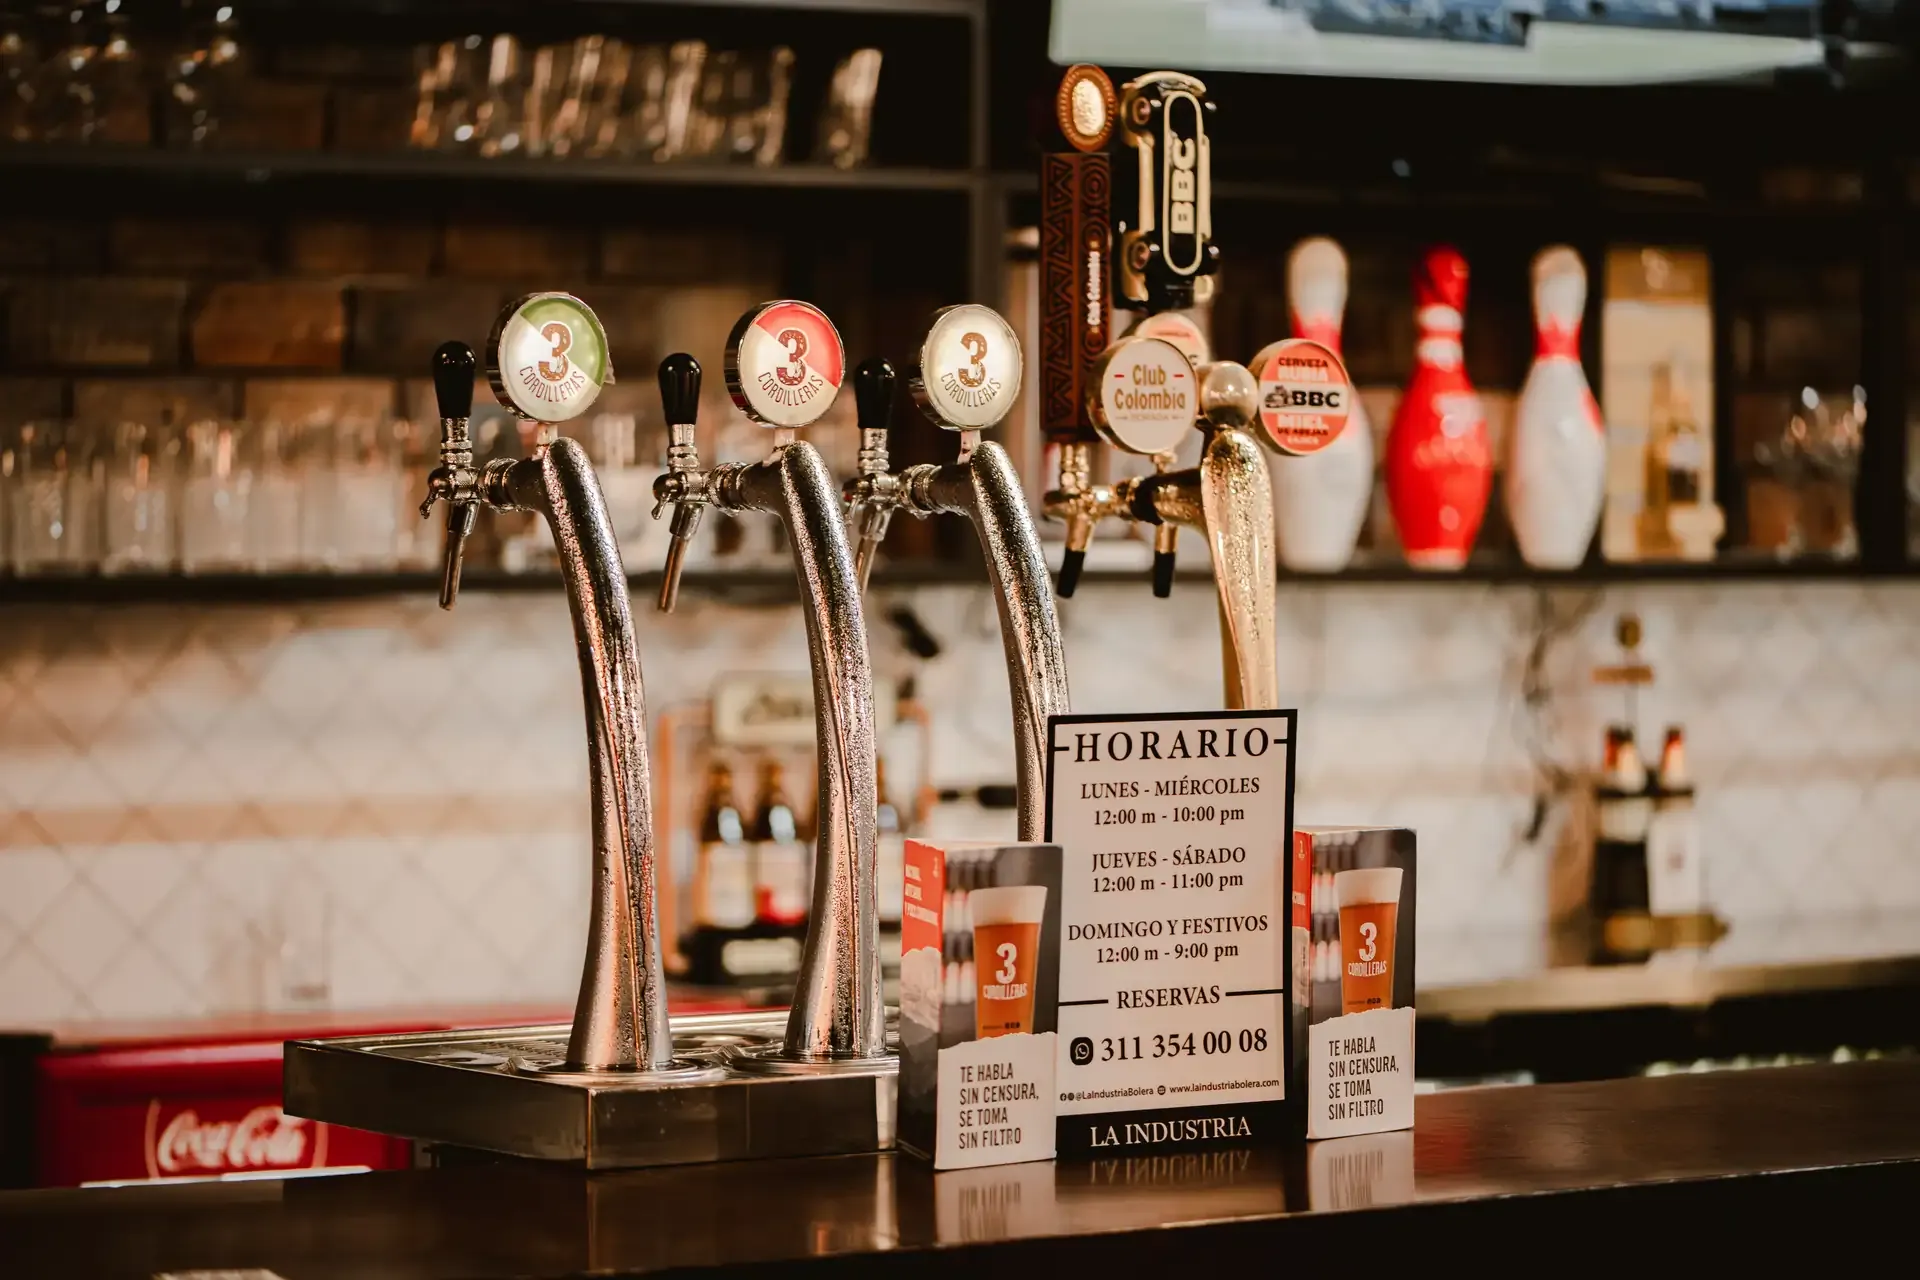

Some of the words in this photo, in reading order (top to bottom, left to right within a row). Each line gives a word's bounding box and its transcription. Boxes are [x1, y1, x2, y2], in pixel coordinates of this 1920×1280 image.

[1171, 137, 1196, 234] BBC
[538, 322, 573, 382] 3
[776, 329, 808, 386] 3
[958, 332, 988, 388] 3
[1278, 357, 1329, 368] CERVEZA
[519, 365, 586, 402] CORDILLERAS
[1132, 364, 1167, 386] Club
[758, 371, 824, 406] CORDILLERAS
[941, 372, 1002, 408] CORDILLERAS
[1114, 387, 1186, 410] Colombia
[1292, 390, 1340, 408] BBC
[1074, 727, 1269, 762] HORARIO
[1081, 781, 1139, 799] LUNES
[1154, 775, 1260, 797] MIÉRCOLES
[1094, 808, 1136, 825] 12:00
[1141, 812, 1156, 824] m
[1172, 806, 1215, 823] 10:00
[1220, 808, 1245, 825] pm
[1092, 851, 1157, 872] JUEVES
[1172, 845, 1246, 865] SÁBADO
[1093, 876, 1135, 893] 12:00
[1140, 878, 1155, 890] m
[1172, 872, 1214, 889] 11:00
[1219, 873, 1243, 891] pm
[1068, 919, 1163, 941] DOMINGO
[1167, 919, 1179, 936] Y
[1182, 915, 1268, 935] FESTIVOS
[1097, 946, 1139, 963] 12:00
[1144, 948, 1159, 960] m
[1174, 943, 1208, 959] 9:00
[1214, 944, 1239, 962] pm
[1358, 922, 1378, 962] 3
[995, 942, 1018, 984] 3
[1348, 960, 1387, 977] CORDILLERAS
[1116, 985, 1220, 1009] RESERVAS
[1101, 1036, 1144, 1061] 311
[1152, 1032, 1196, 1058] 354
[1203, 1030, 1231, 1055] 00
[1239, 1027, 1268, 1052] 08
[1329, 1040, 1340, 1056] TE
[1343, 1036, 1376, 1055] HABLA
[960, 1065, 973, 1083] TE
[977, 1062, 1014, 1082] HABLA
[1328, 1060, 1345, 1078] SIN
[1349, 1055, 1399, 1076] CENSURA,
[959, 1087, 979, 1105] SIN
[983, 1082, 1039, 1103] CENSURA,
[1169, 1078, 1280, 1094] www.laindustriabolera.com
[1328, 1082, 1340, 1099] SE
[1344, 1079, 1371, 1097] TOMA
[959, 1109, 972, 1127] SE
[977, 1106, 1008, 1126] TOMA
[1328, 1102, 1345, 1120] SIN
[1349, 1098, 1384, 1118] FILTRO
[959, 1130, 978, 1149] SIN
[982, 1127, 1021, 1147] FILTRO
[1090, 1124, 1120, 1147] LA
[1125, 1116, 1252, 1145] INDUSTRIA
